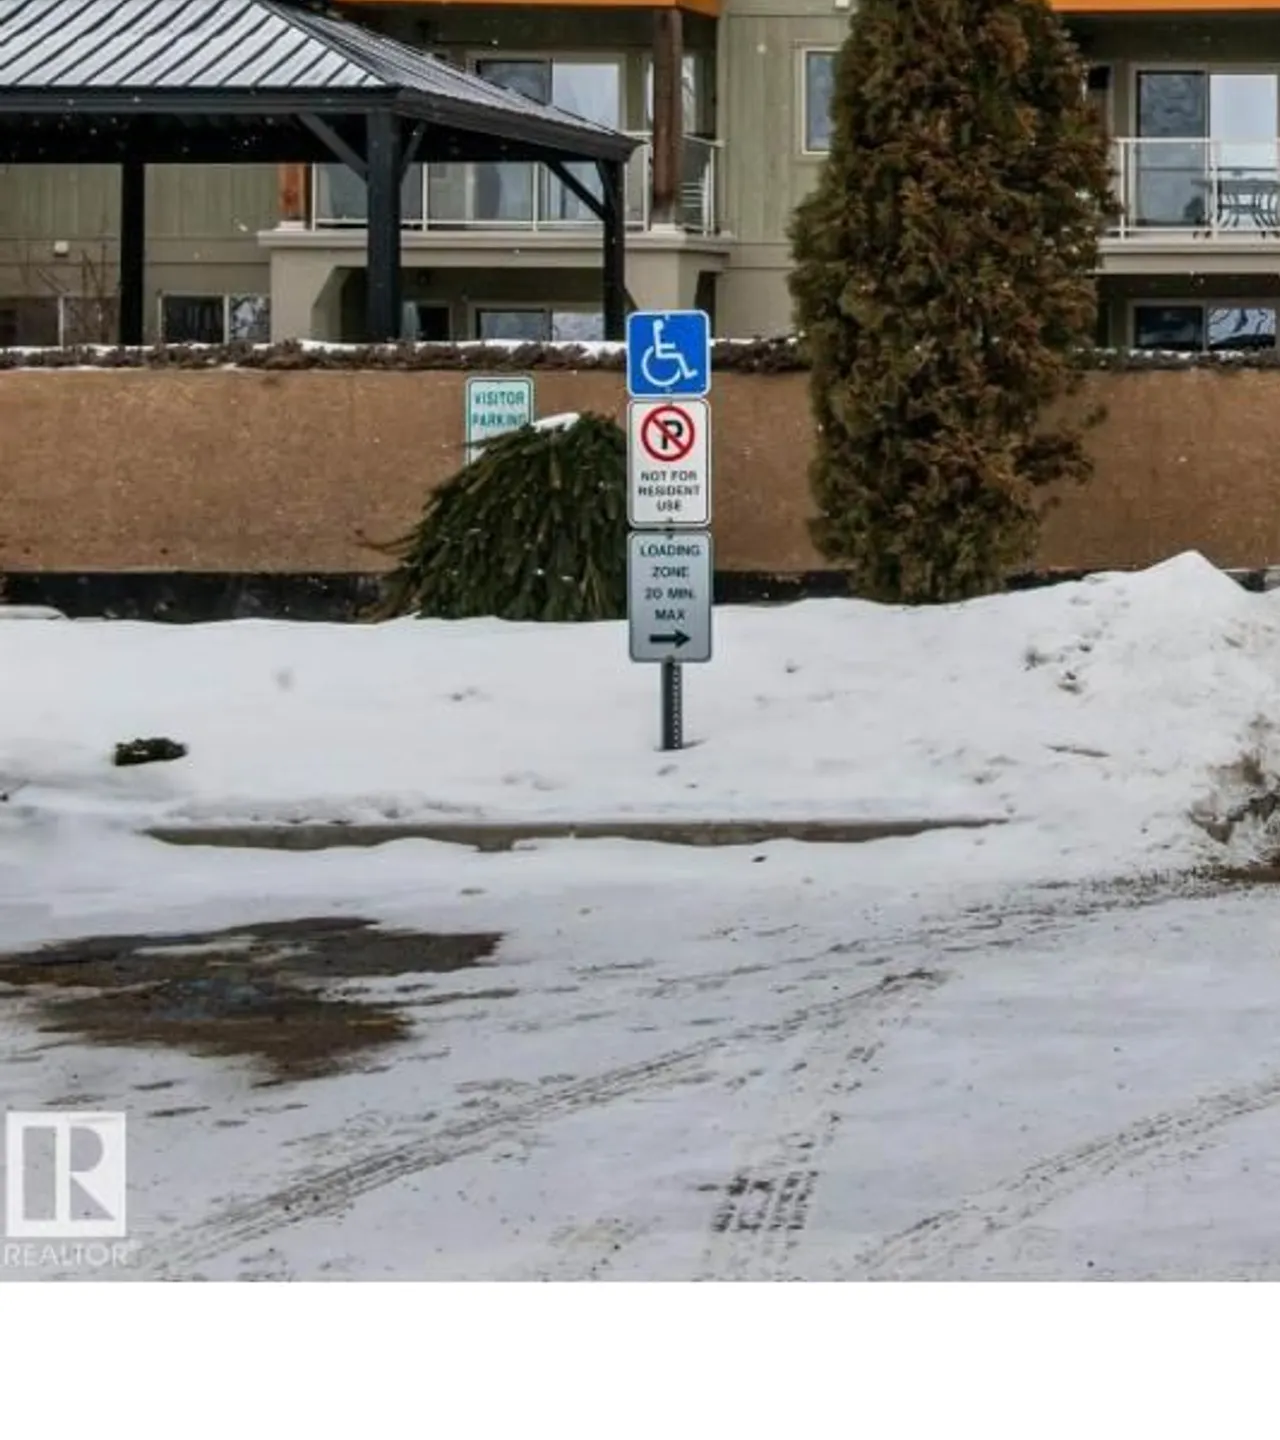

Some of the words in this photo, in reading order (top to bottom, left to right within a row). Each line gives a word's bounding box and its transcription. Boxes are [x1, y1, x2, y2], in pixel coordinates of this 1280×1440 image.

[475, 391, 525, 405] VISITOR
[472, 413, 527, 428] PARKING
[641, 471, 666, 481] NOT
[670, 471, 697, 481] FOR
[638, 486, 700, 496] RESIDENT
[656, 500, 681, 511] USE
[641, 544, 701, 556] LOADING
[652, 566, 689, 578] ZONE
[645, 588, 664, 600] 20
[654, 609, 685, 620] MAX
